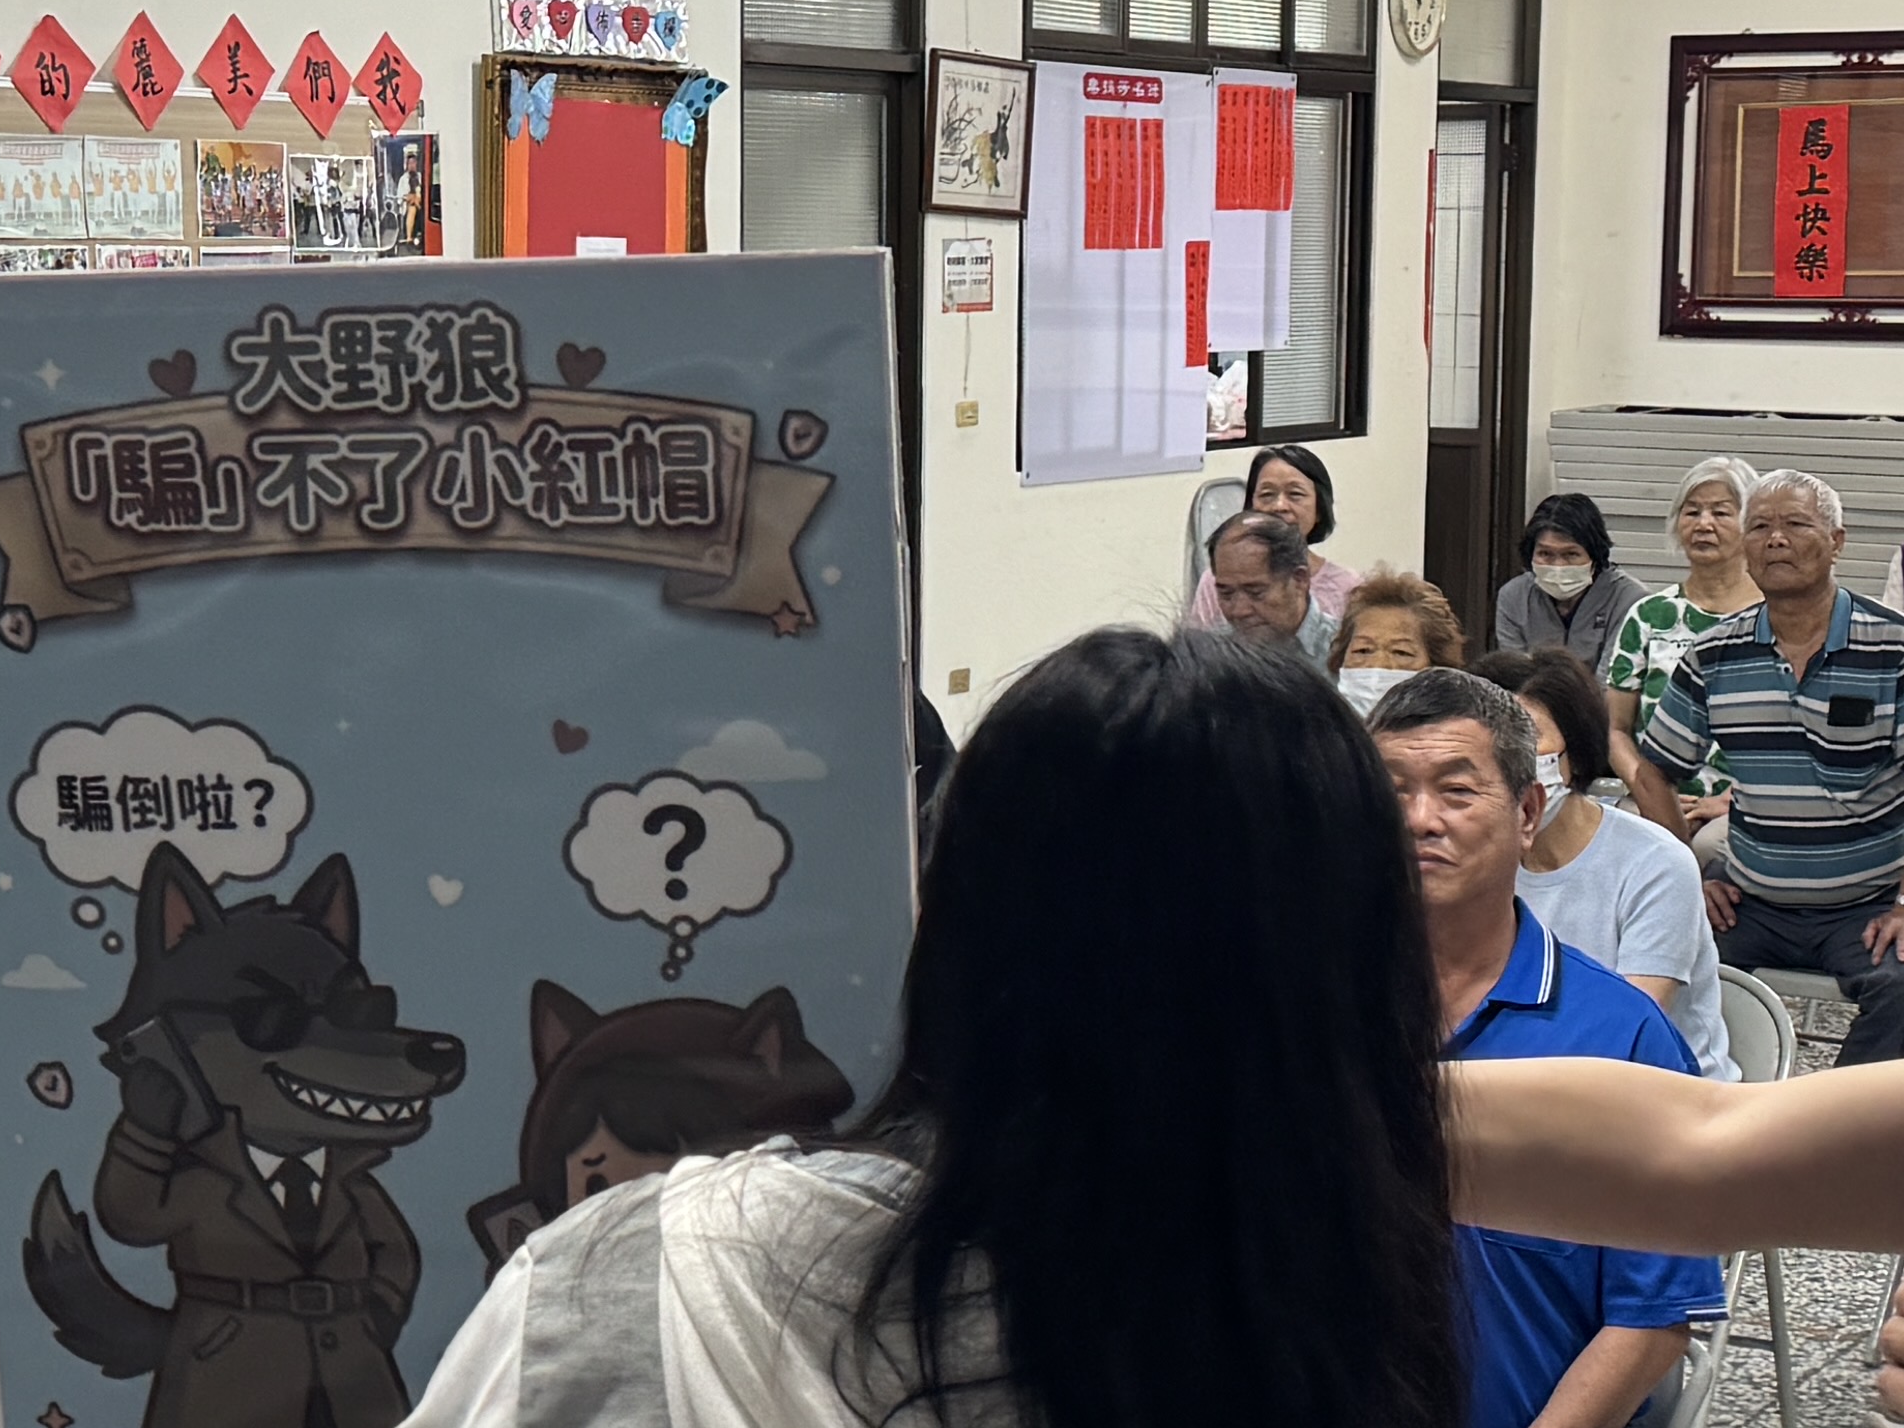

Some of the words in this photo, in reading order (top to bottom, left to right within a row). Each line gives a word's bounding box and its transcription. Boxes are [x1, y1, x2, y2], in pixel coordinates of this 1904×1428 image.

[1794, 117, 1834, 283] 馬上快樂
[228, 306, 521, 415] 大野狼
[65, 417, 725, 532] 「騙」不了小紅帽
[55, 774, 277, 834] 騙倒啦？
